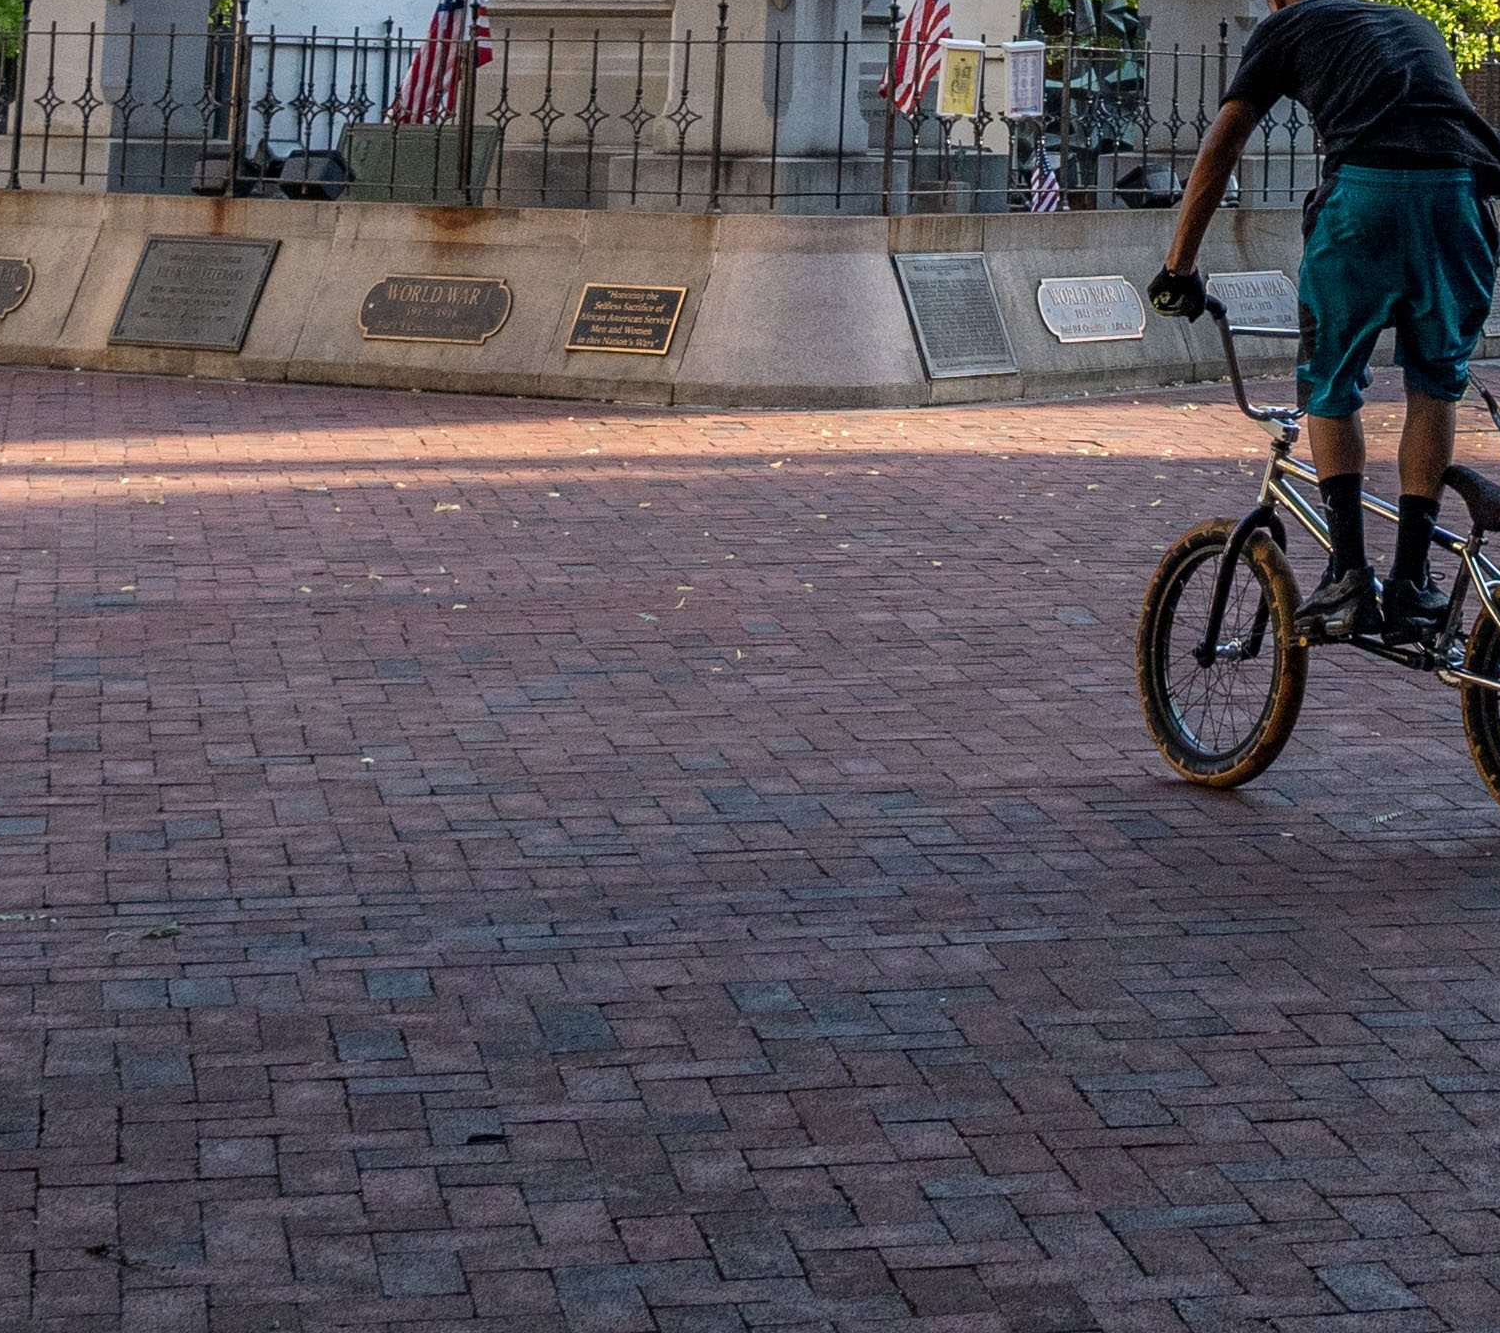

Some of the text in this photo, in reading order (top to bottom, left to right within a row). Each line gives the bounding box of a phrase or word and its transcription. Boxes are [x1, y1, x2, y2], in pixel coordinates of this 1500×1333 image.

[387, 284, 444, 303] WORLD
[447, 286, 480, 305] WAR
[1048, 287, 1091, 306] WORLD
[1090, 285, 1117, 304] WAR
[1213, 279, 1287, 300] VIETNAM WAR
[607, 313, 642, 323] American
[644, 315, 672, 325] Service
[590, 325, 652, 336] Men and Women
[586, 335, 601, 344] this
